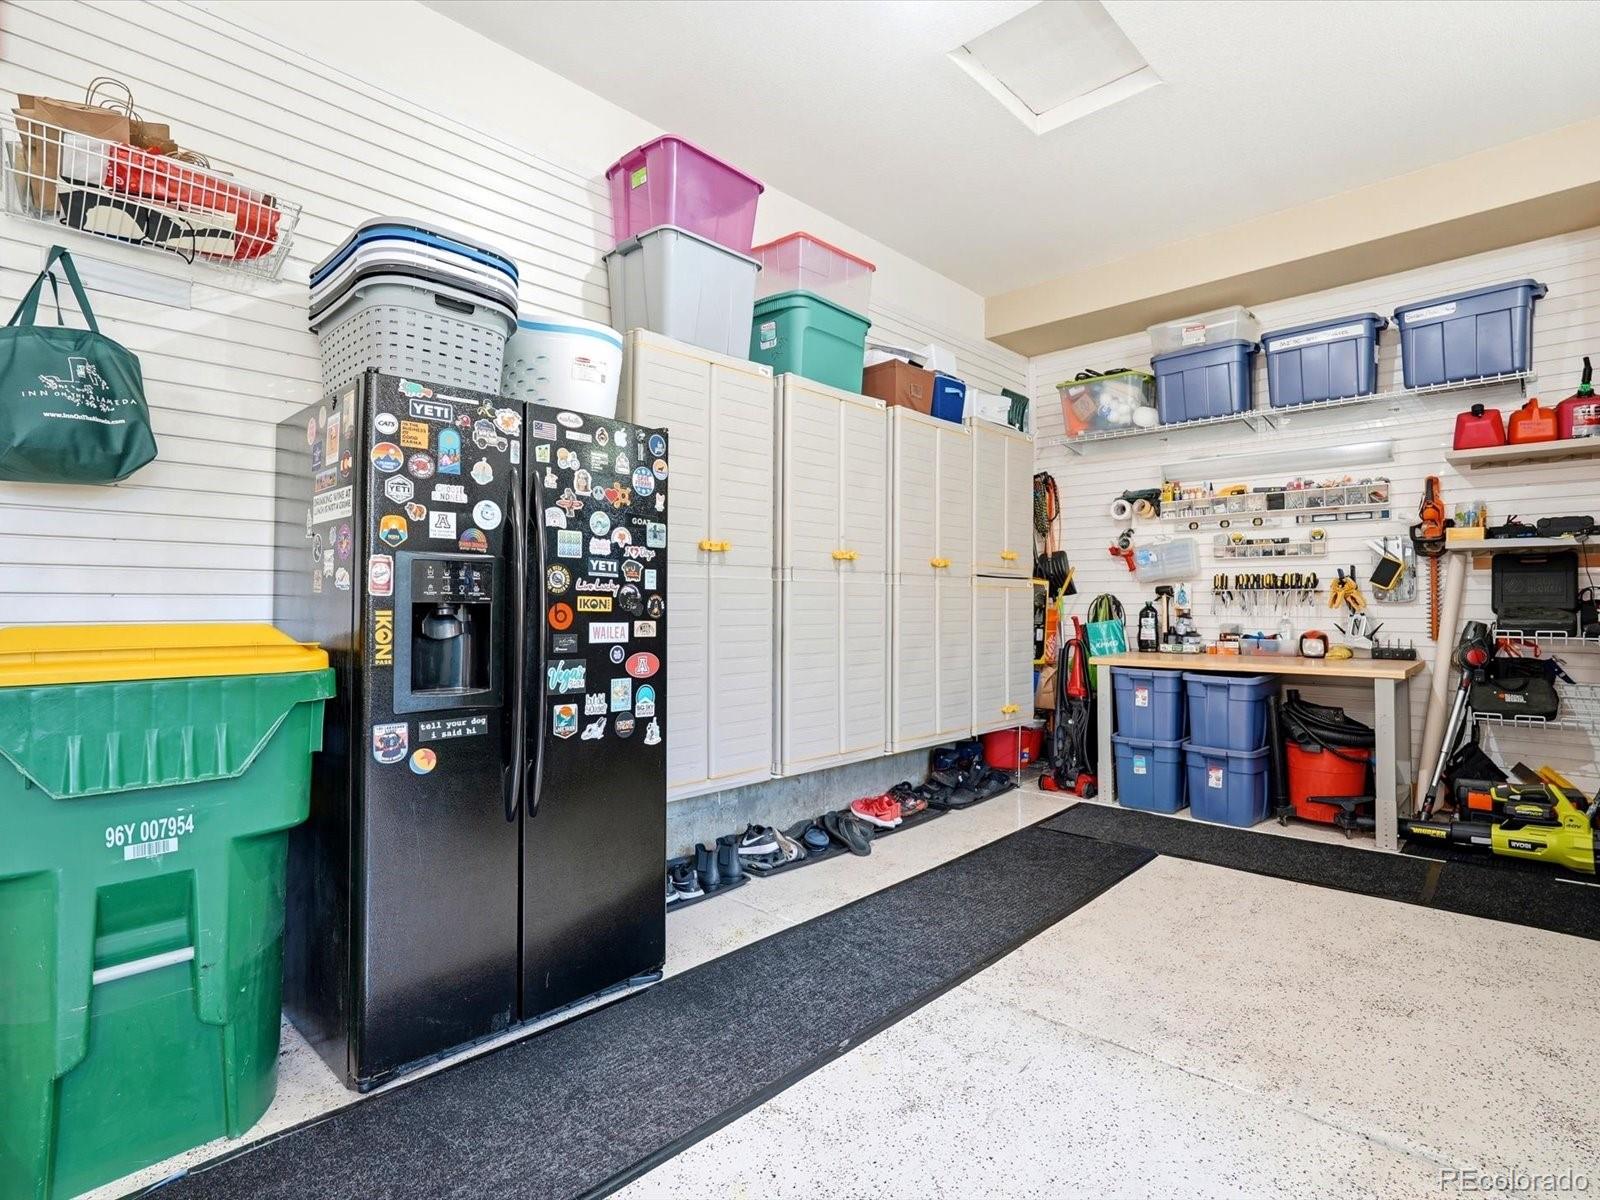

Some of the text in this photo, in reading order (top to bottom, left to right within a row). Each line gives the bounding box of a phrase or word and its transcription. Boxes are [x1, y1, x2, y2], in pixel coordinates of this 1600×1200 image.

[89, 394, 137, 406] ALAMEDA
[412, 402, 449, 419] YETI
[389, 485, 410, 493] YETI
[589, 560, 617, 572] YETI
[579, 598, 608, 609] IKON
[375, 610, 393, 659] IKON
[592, 625, 626, 640] WAILEA
[420, 717, 487, 731] tell your dog
[441, 728, 462, 737] said
[466, 727, 477, 735] hi
[105, 813, 195, 848] 96Y 007954
[1510, 841, 1532, 850] RYOBI
